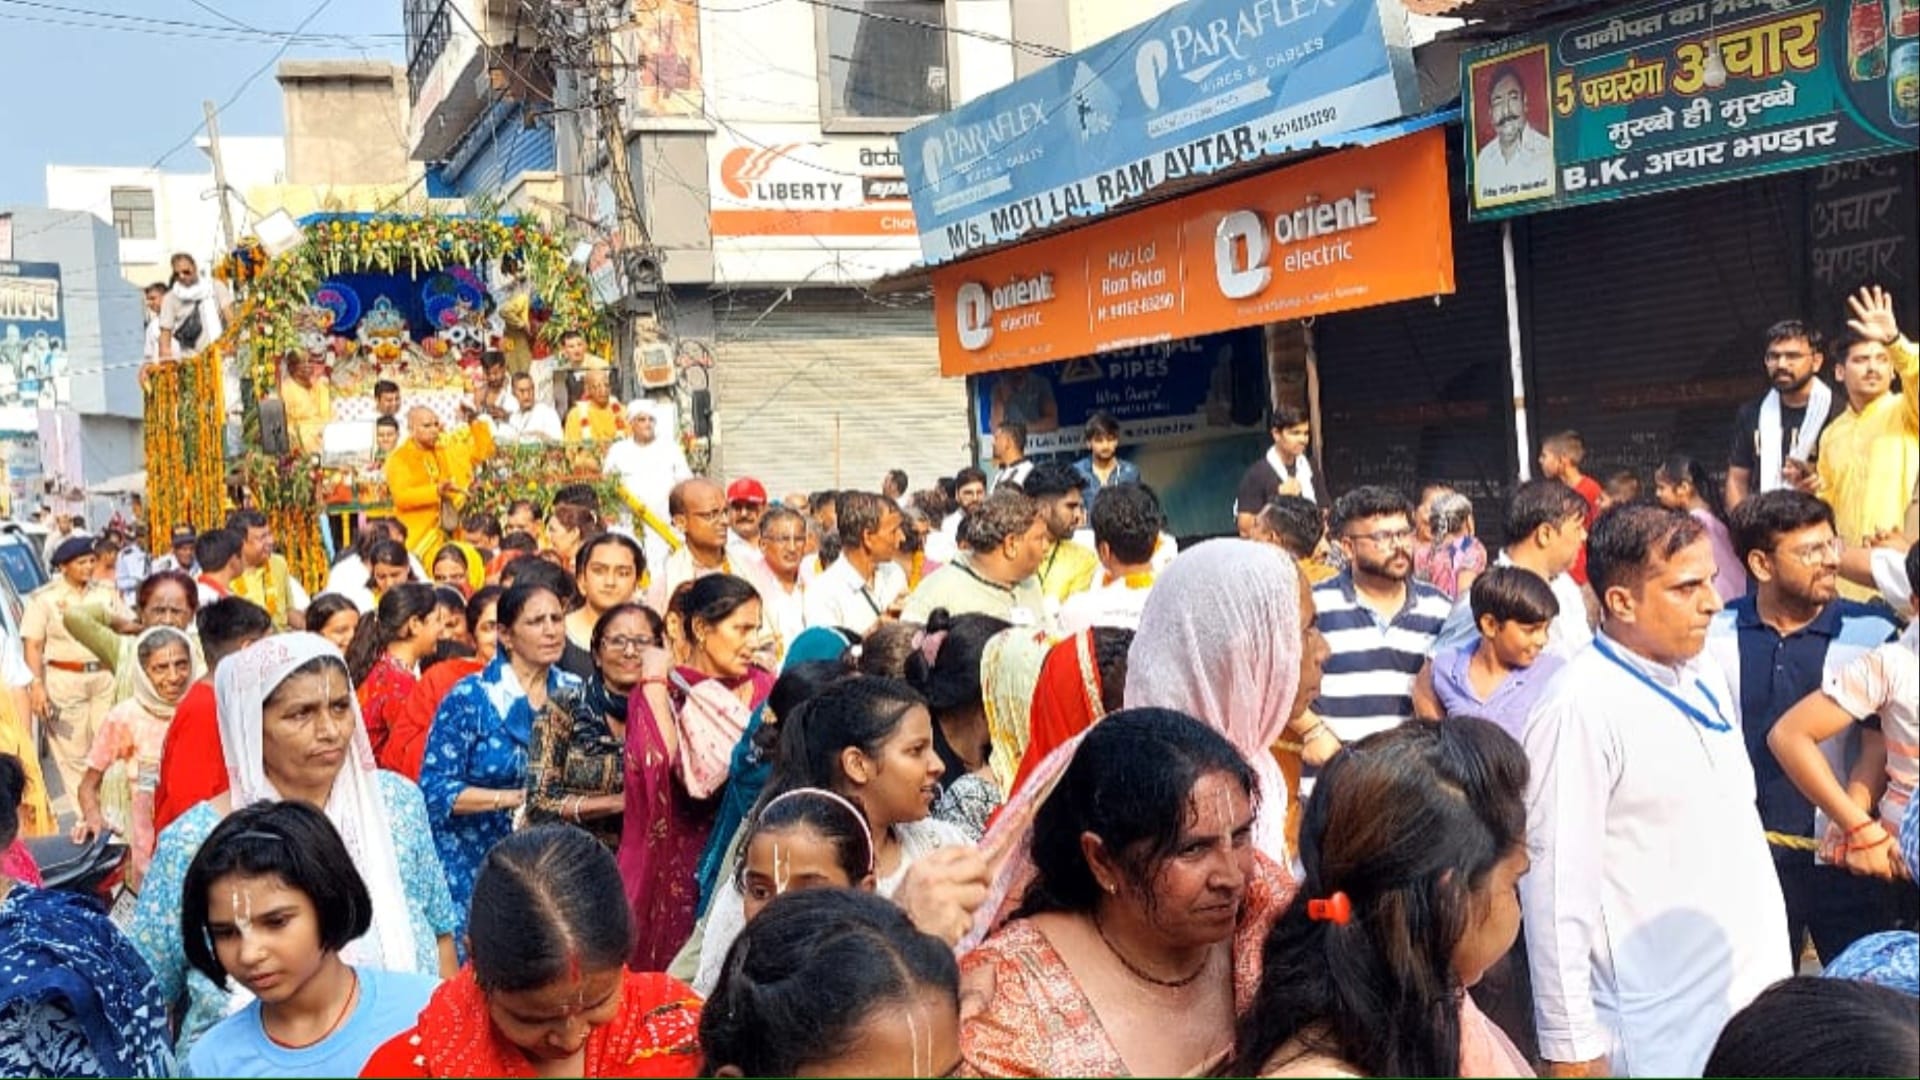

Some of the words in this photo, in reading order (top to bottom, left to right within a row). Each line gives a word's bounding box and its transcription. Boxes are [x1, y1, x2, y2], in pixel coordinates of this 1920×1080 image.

[1574, 13, 1664, 50] पानीपत
[1668, 3, 1704, 25] का
[1556, 72, 1575, 114] 5
[1580, 60, 1665, 107] पचरंगा
[1673, 10, 1822, 94] अचार
[944, 98, 1049, 164] PARAFLEX
[1682, 97, 1712, 128] ही
[1563, 158, 1639, 191] B.K.
[1644, 141, 1728, 175] अचार
[1733, 121, 1838, 158] भण्डार
[757, 182, 843, 201] LIBERTY
[990, 197, 1044, 236] MOTI
[1050, 183, 1091, 219] LAL
[1096, 160, 1155, 204] RAM
[1164, 125, 1255, 179] AVTAR
[1275, 188, 1378, 244] orient
[1284, 238, 1353, 272] electric
[992, 272, 1055, 310] orient
[1001, 309, 1043, 332] electric
[1109, 359, 1169, 379] PIPES
